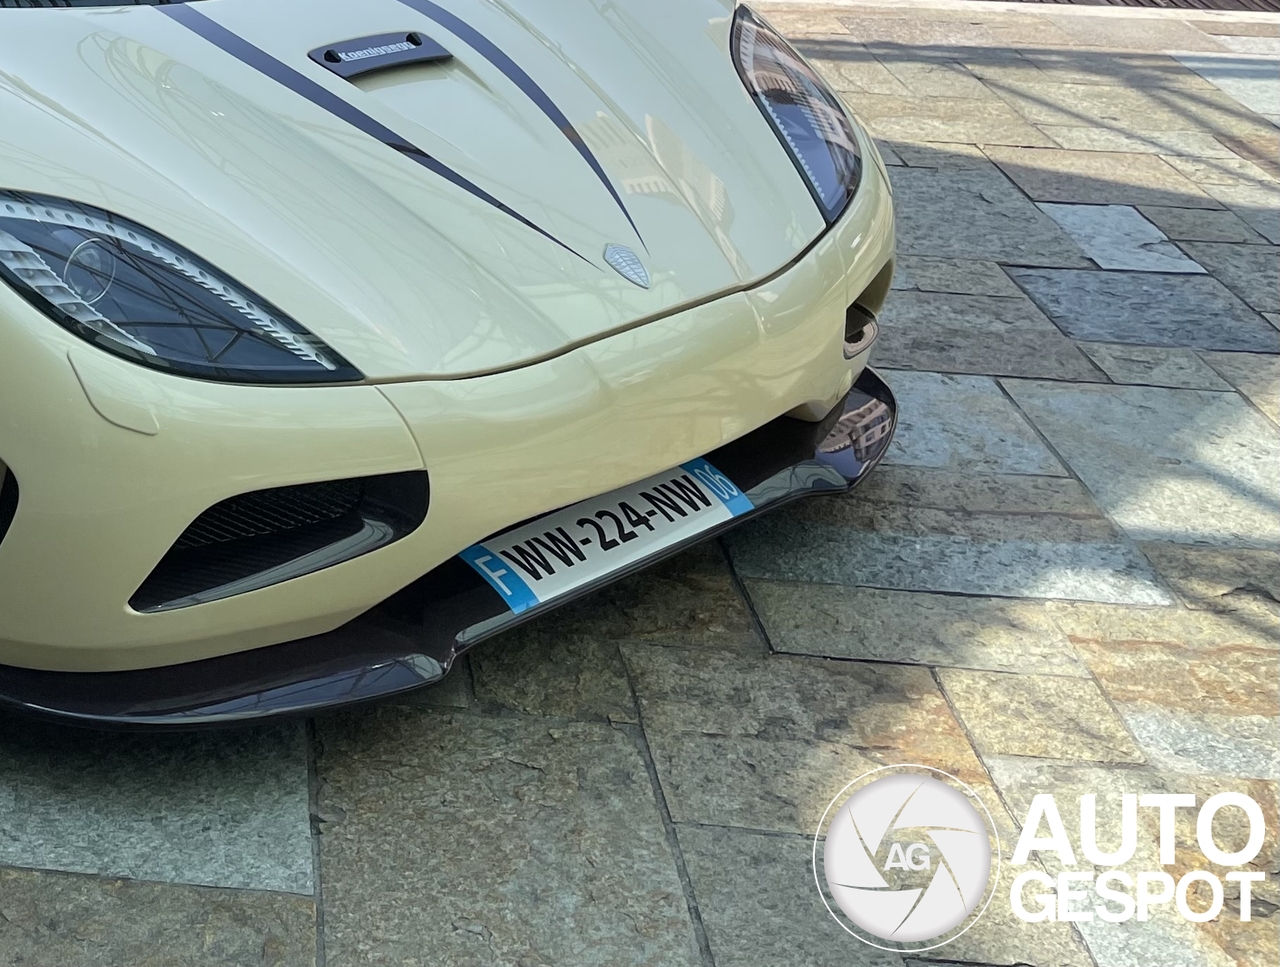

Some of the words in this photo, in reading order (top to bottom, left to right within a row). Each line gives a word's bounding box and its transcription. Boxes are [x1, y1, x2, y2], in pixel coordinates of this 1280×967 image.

[338, 41, 417, 62] Koenigsegg
[694, 464, 738, 500] 06
[474, 555, 513, 596] F
[500, 474, 713, 581] WW-224-NW
